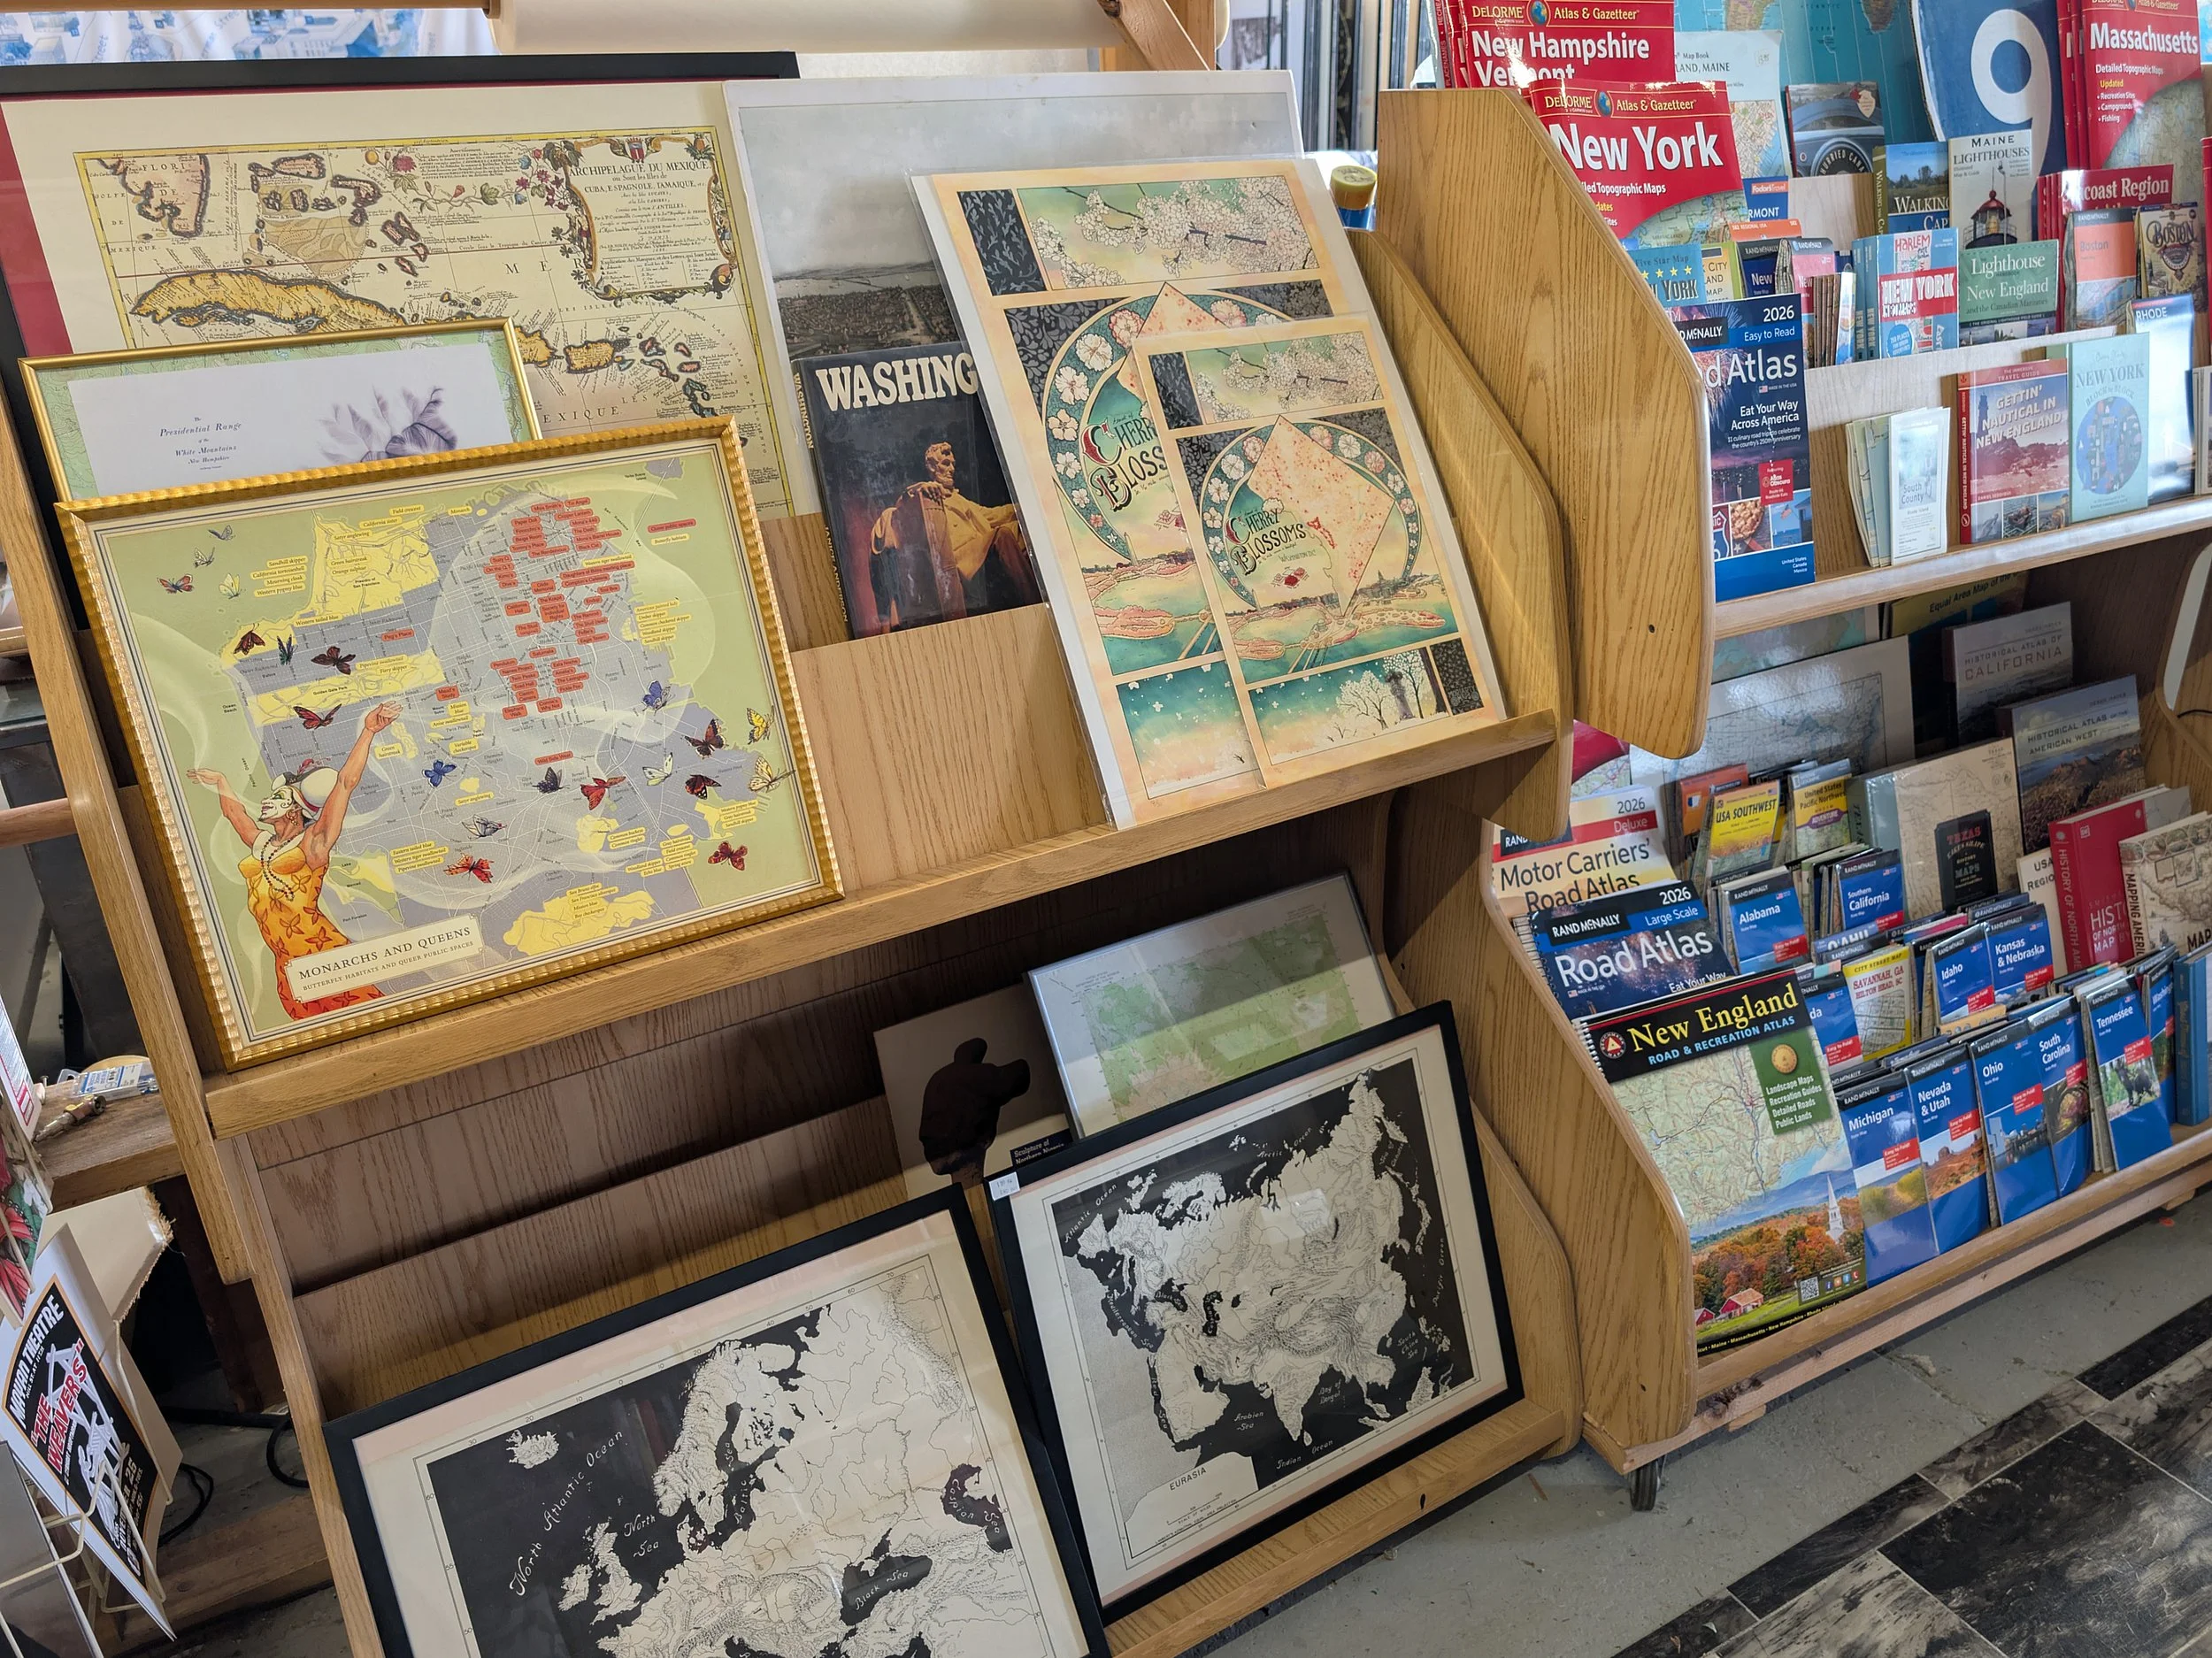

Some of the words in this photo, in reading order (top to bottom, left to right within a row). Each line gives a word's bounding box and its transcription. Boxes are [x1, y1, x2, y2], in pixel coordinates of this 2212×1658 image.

[1554, 9, 1578, 19] Atlas
[1582, 8, 1590, 19] &
[1593, 8, 1637, 20] Gazetteer
[1471, 31, 1524, 58] New
[1529, 31, 1649, 65] Hampshire
[2091, 22, 2198, 54] Massachusetts
[1702, 63, 1731, 72] MAINE
[2095, 64, 2122, 73] Detailed
[2101, 80, 2124, 89] Updated
[1617, 99, 1638, 111] Atlas
[1650, 99, 1695, 111] Gazetteer
[1548, 123, 1627, 170] New
[1632, 122, 1724, 170] York
[1971, 135, 2015, 149] MAINE
[1954, 147, 2030, 165] LIGHTHOUSES
[569, 162, 646, 178] ARCHIPELAGUE
[649, 163, 663, 173] DU
[1596, 183, 1642, 196] Topographic
[1644, 183, 1667, 195] Maps
[2121, 176, 2169, 202] Region
[2079, 240, 2108, 252] Boston
[1971, 254, 2046, 279] Lighthouse
[1663, 279, 1698, 302] YORK
[1751, 273, 1773, 287] New
[1882, 278, 1913, 303] NEW
[1916, 272, 1955, 301] YORK
[1967, 286, 1997, 301] New
[2000, 278, 2049, 299] England
[1763, 305, 1794, 323] 2026
[2136, 307, 2167, 321] RHODE
[1745, 329, 1762, 343] Easy
[1763, 330, 1772, 340] to
[1775, 326, 1796, 338] Read
[1727, 348, 1798, 386] Atlas
[2076, 368, 2108, 388] NEW
[2109, 363, 2146, 383] YORK
[815, 352, 979, 411] WASHING
[1996, 384, 2043, 411] GETTIN'
[1740, 405, 1755, 418] Eat
[1756, 403, 1777, 416] Your
[1778, 400, 1799, 412] Way
[1982, 402, 2040, 432] NAUTICAL
[2044, 395, 2057, 411] IN
[160, 425, 211, 437] Presidential
[215, 422, 242, 431] Range
[1731, 419, 1760, 432] Across
[1761, 412, 1800, 426] America
[1976, 430, 2005, 449] NEW
[2006, 413, 2062, 440] ENGLAND
[198, 445, 237, 454] Mountains
[1225, 508, 1281, 545] CHERRY
[1230, 523, 1307, 576] BLOSSOMS
[1929, 596, 1951, 613] Equal
[1953, 589, 1971, 603] Area
[1972, 582, 1989, 596] Map
[1965, 647, 2017, 664] HISTORICAL
[1965, 646, 2062, 682] CALIFORNIA
[2028, 723, 2078, 743] HISTORICAL
[2081, 714, 2108, 726] ATLAS
[2029, 738, 2072, 755] AMERICAN
[2075, 729, 2098, 741] WEST
[1804, 787, 1824, 799] United
[1824, 782, 1842, 794] States
[1617, 798, 1646, 815] 2026
[1716, 810, 1731, 824] USA
[1732, 799, 1777, 820] SOUTHWEST
[1613, 818, 1648, 833] Deluxe
[1947, 826, 1982, 846] TEXAS
[1501, 862, 1563, 892] Motor
[1566, 839, 1651, 875] Carriers'
[2034, 857, 2053, 871] USA
[2059, 848, 2072, 894] HISTORY
[1524, 886, 1582, 913] Road
[1586, 872, 1641, 899] Atlas
[1659, 886, 1692, 906] 2026
[1847, 887, 1872, 899] Southern
[1849, 890, 1890, 911] California
[2125, 873, 2141, 918] MAPPING
[1645, 912, 1674, 927] Large
[1675, 906, 1698, 920] Scale
[1739, 904, 1781, 925] Alabama
[1552, 924, 1580, 938] RAND
[299, 951, 379, 980] MONARCHS
[383, 942, 413, 958] AND
[418, 926, 471, 948] QUEENS
[1995, 939, 2025, 956] Kansas
[1997, 956, 2005, 968] &
[2006, 944, 2045, 965] Nebraska
[2093, 937, 2115, 954] MAP
[303, 976, 343, 991] BUTTERFLY
[345, 966, 380, 981] HABITATS
[381, 961, 397, 971] AND
[398, 955, 422, 967] QUEER
[424, 948, 449, 960] PUBLIC
[449, 940, 474, 953] SPACES
[1555, 940, 1638, 988] Road
[1640, 930, 1714, 970] Atlas
[1869, 958, 1890, 970] STREET
[1853, 969, 1892, 989] SAVANNAH,
[1941, 962, 1963, 981] Idaho
[1669, 979, 1686, 994] Eat
[1686, 975, 1707, 991] Your
[1627, 1019, 1690, 1053] New
[1695, 982, 1799, 1034] England
[2096, 1006, 2134, 1029] Tennessee
[1647, 1049, 1679, 1065] ROAD
[1683, 1045, 1692, 1055] &
[1695, 1025, 1761, 1052] RECREATION
[1763, 1016, 1795, 1032] ATLAS
[2039, 1033, 2061, 1052] South
[2042, 1044, 2070, 1064] Carolina
[1983, 1062, 2003, 1078] Ohio
[1766, 1080, 1797, 1095] Landscape
[1798, 1074, 1814, 1088] Maps
[1918, 1081, 1952, 1103] Nevada
[1770, 1091, 1801, 1106] Recreation
[1802, 1085, 1822, 1097] Guides
[1921, 1106, 1929, 1117] &
[1930, 1095, 1951, 1113] Utah
[1772, 1104, 1798, 1117] Detailed
[1798, 1099, 1816, 1111] Roads
[1775, 1117, 1793, 1129] Public
[1794, 1111, 1813, 1125] Lands
[1848, 1107, 1894, 1132] Michigan
[1014, 1141, 1043, 1158] Sculpture
[1015, 1150, 1042, 1164] Northern
[1064, 1209, 1091, 1243] Atlantic
[1095, 1184, 1118, 1206] Ocean
[9, 1358, 30, 1430] MAYAN
[21, 1294, 65, 1362] THEATRE
[1233, 1410, 1264, 1422] Arabian
[1237, 1422, 1255, 1432] Sea
[726, 1442, 735, 1469] Sea
[1276, 1455, 1302, 1470] Indian
[1311, 1439, 1334, 1455] Ocean
[1169, 1467, 1208, 1492] EURASIA
[733, 1479, 748, 1525] Baltic
[947, 1478, 975, 1519] Caspian
[984, 1510, 1001, 1534] Sea
[509, 1542, 542, 1597] North
[543, 1471, 586, 1531] Atlantic
[586, 1430, 623, 1468] Ocean
[624, 1514, 657, 1538] North
[634, 1541, 659, 1558] Sea
[855, 1585, 880, 1610] Black
[886, 1569, 910, 1583] Sea
